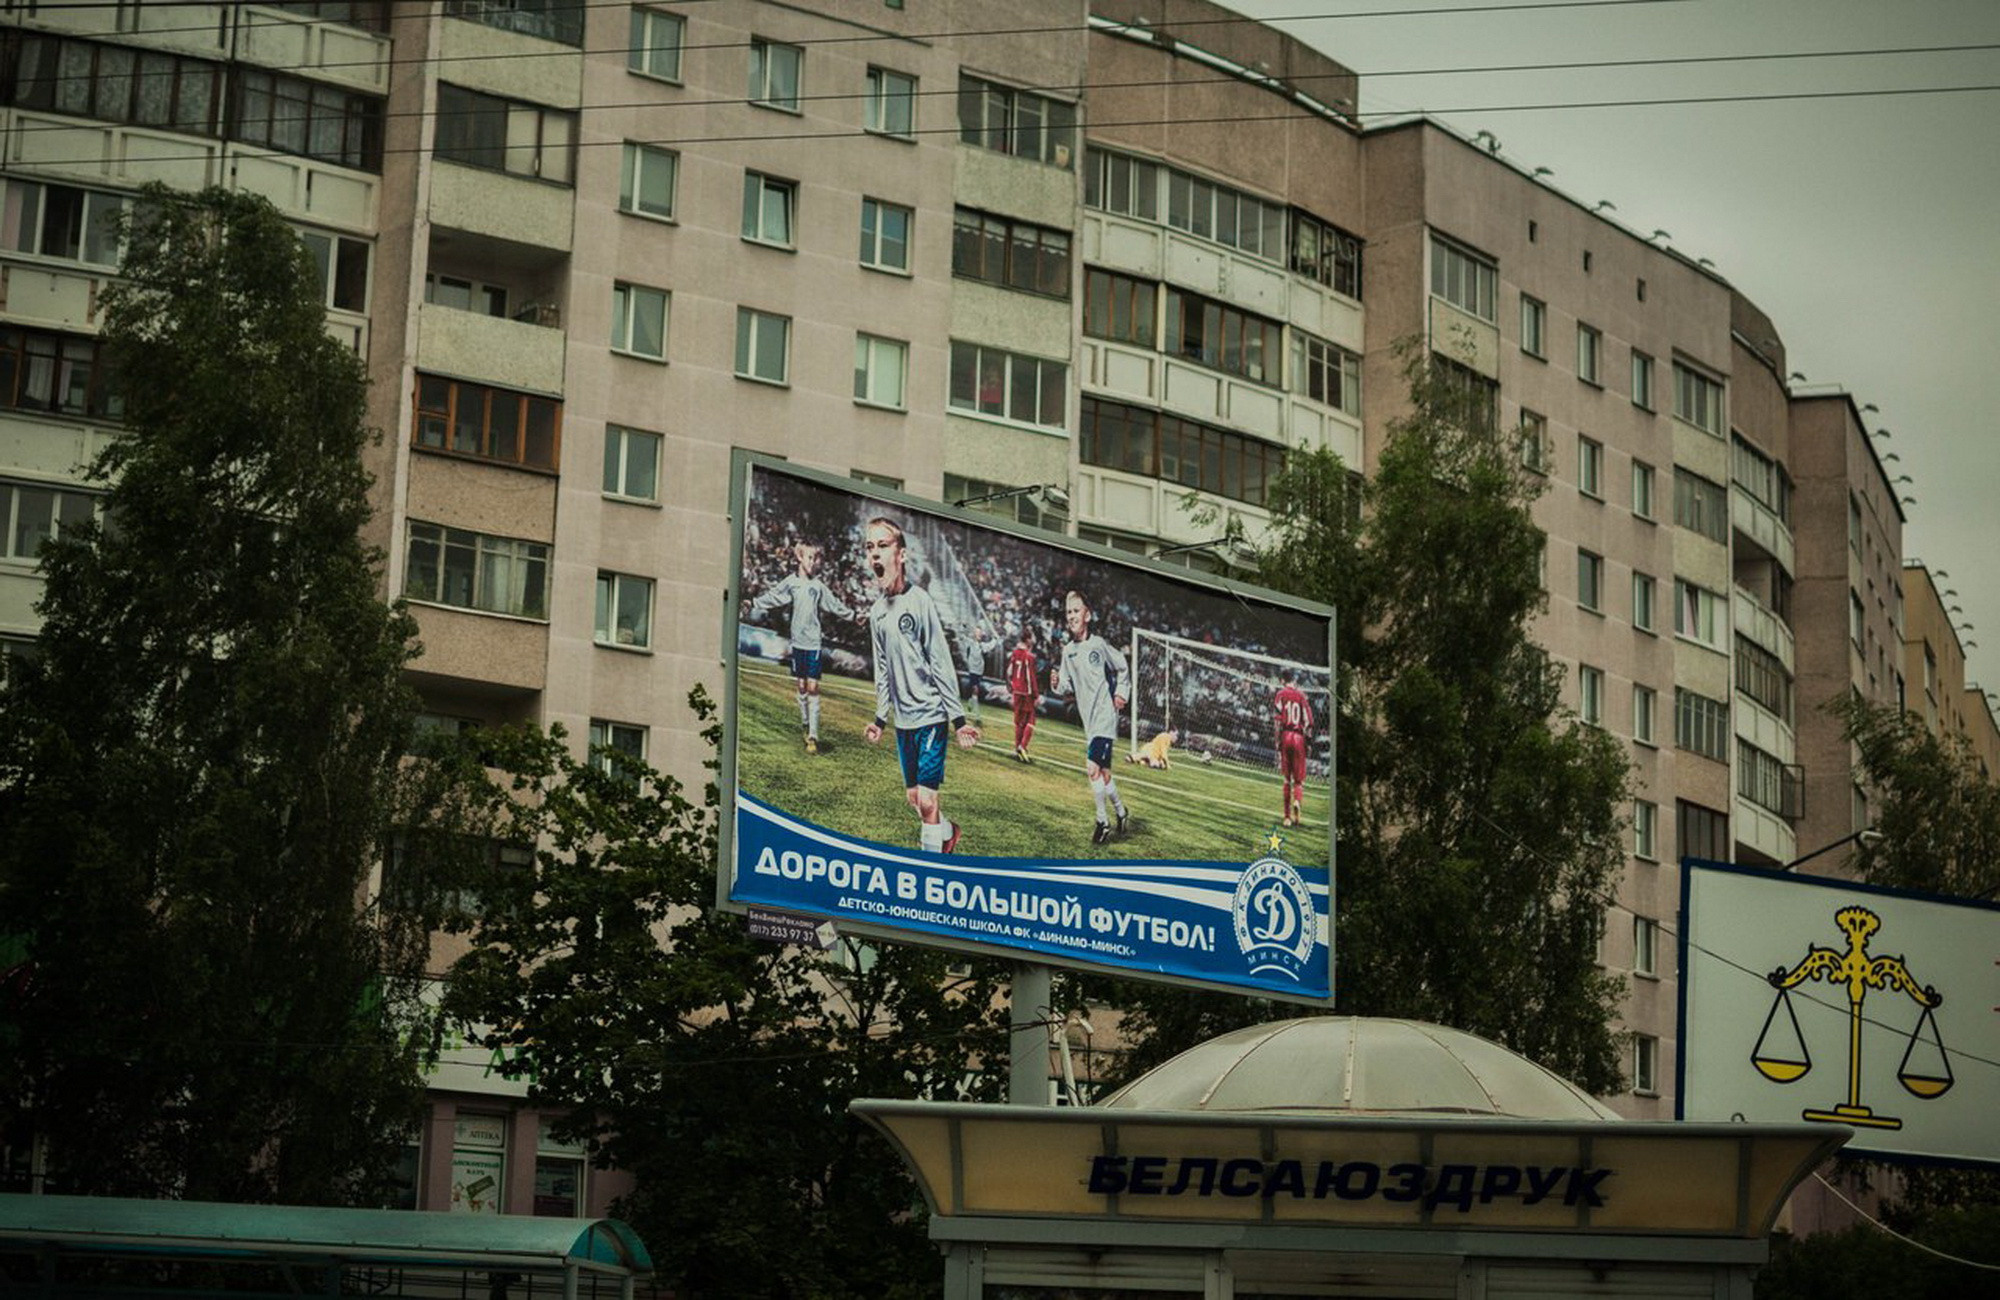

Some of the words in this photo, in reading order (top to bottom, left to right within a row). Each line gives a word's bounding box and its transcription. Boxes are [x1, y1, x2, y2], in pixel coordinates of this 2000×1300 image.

[1284, 700, 1300, 725] 10
[754, 846, 890, 896] ДОРОГА
[896, 871, 918, 900] В
[925, 876, 1083, 929] БОЛЬШОЙ
[1088, 907, 1216, 952] ФУТБОЛ!
[749, 924, 770, 935] (017)
[770, 925, 788, 938] 233
[789, 928, 800, 940] 97
[802, 930, 814, 942] 37
[838, 896, 967, 928] ДЕТСКО-ЮНОШЕСКАЯ
[968, 917, 1012, 936] ШКОЛА
[1013, 926, 1031, 939] ФК
[1032, 929, 1137, 956] «ДИНАМО-МИНСК»
[1248, 953, 1300, 971] МИНСК
[1087, 1156, 1612, 1213] БЕЛСАЮЗДРУК
